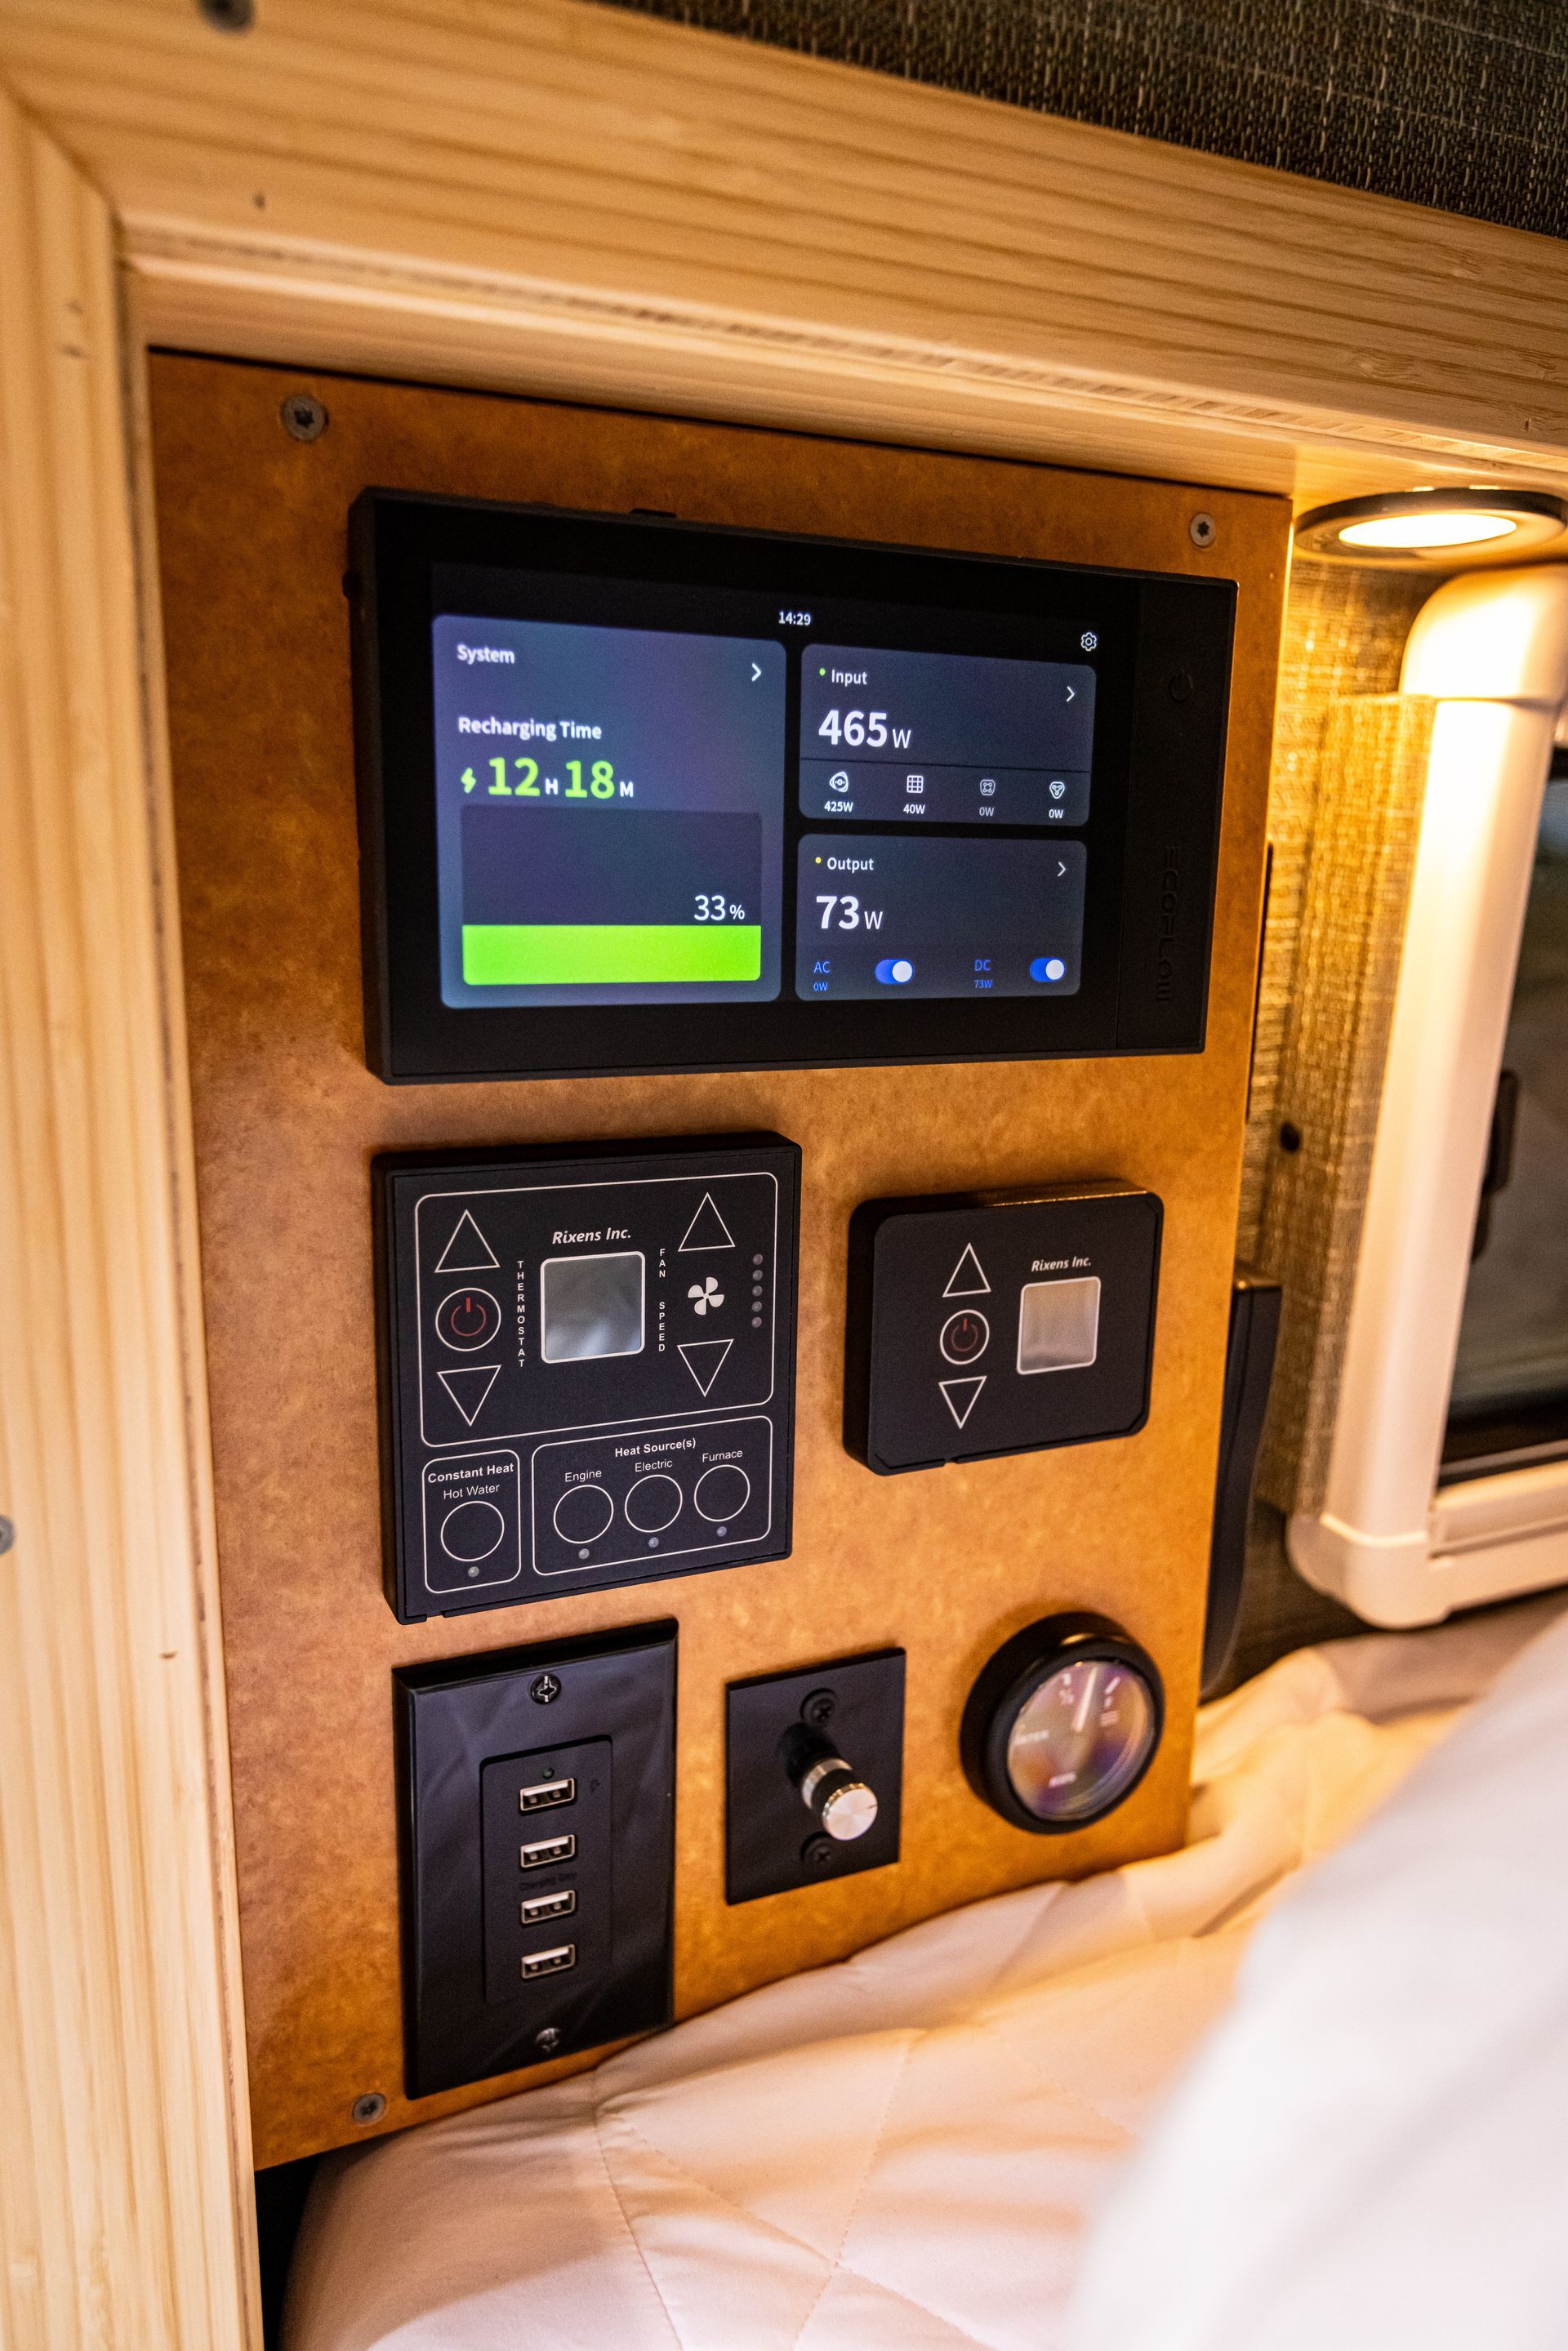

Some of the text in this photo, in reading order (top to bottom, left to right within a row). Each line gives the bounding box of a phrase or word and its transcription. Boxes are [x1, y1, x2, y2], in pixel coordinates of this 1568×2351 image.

[778, 610, 812, 626] 14:29
[457, 643, 515, 666] System
[831, 669, 868, 688] Input
[457, 715, 603, 742] Recharging Time
[823, 800, 853, 813] 425W
[902, 804, 926, 815] 40W
[978, 806, 995, 817] 0W
[1048, 808, 1064, 819] 0W
[826, 857, 875, 874] Output
[813, 960, 831, 974] AC
[974, 959, 991, 972] DC
[813, 982, 828, 992] 0W
[974, 979, 993, 989] 73W
[552, 1227, 631, 1245] Rixens Inc.
[658, 1248, 666, 1278] FAN
[1031, 1255, 1092, 1273] Rixens Inc.
[517, 1260, 526, 1368] THERMOSTAT
[615, 1437, 697, 1458] Heat Source(s)
[702, 1449, 743, 1463] Furnace
[426, 1463, 514, 1485] Constant Heat
[635, 1460, 673, 1472] Electric
[564, 1470, 602, 1483] Engine
[443, 1484, 501, 1500] Hot Water
